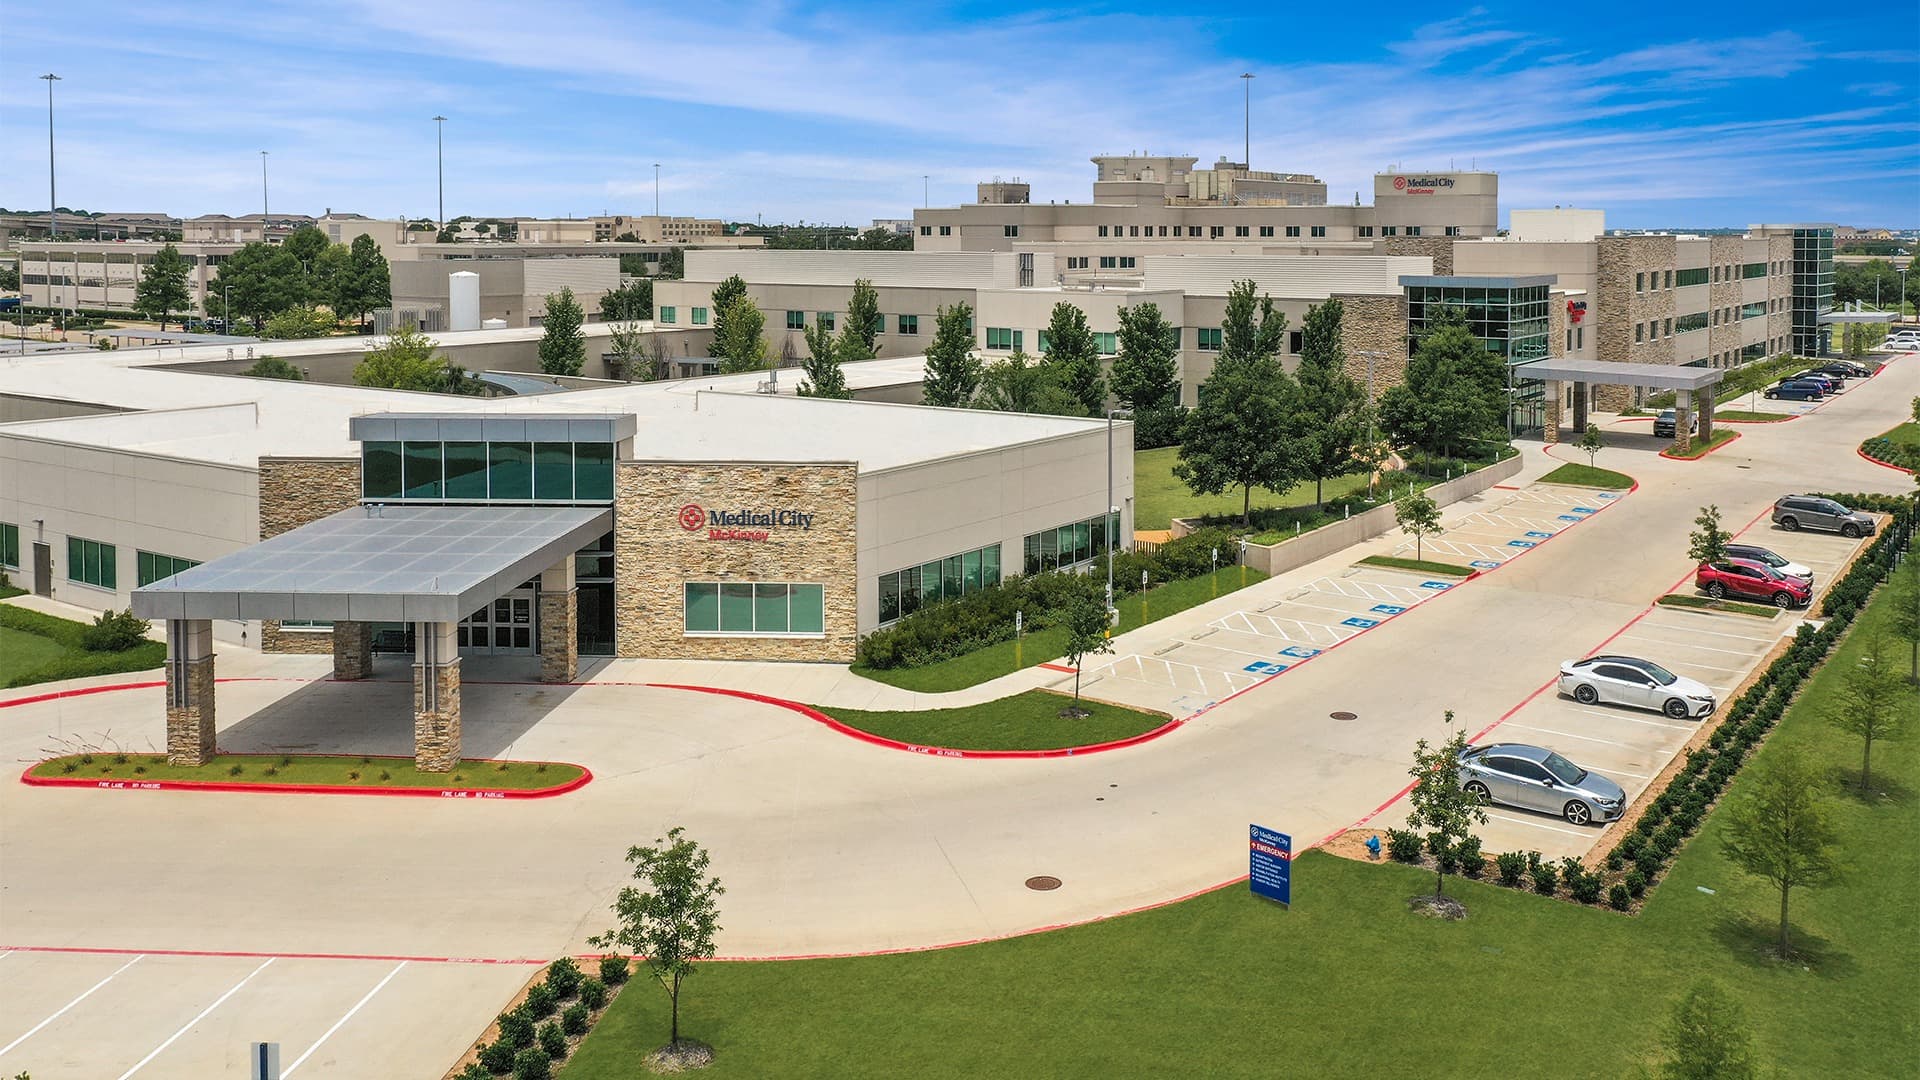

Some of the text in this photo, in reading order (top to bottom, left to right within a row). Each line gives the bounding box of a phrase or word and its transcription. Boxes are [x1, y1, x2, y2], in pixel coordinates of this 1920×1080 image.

[1407, 178, 1455, 188] Medical City
[709, 509, 814, 530] Medical City
[708, 529, 769, 542] McKinney
[1256, 843, 1289, 860] EMERGENCY
